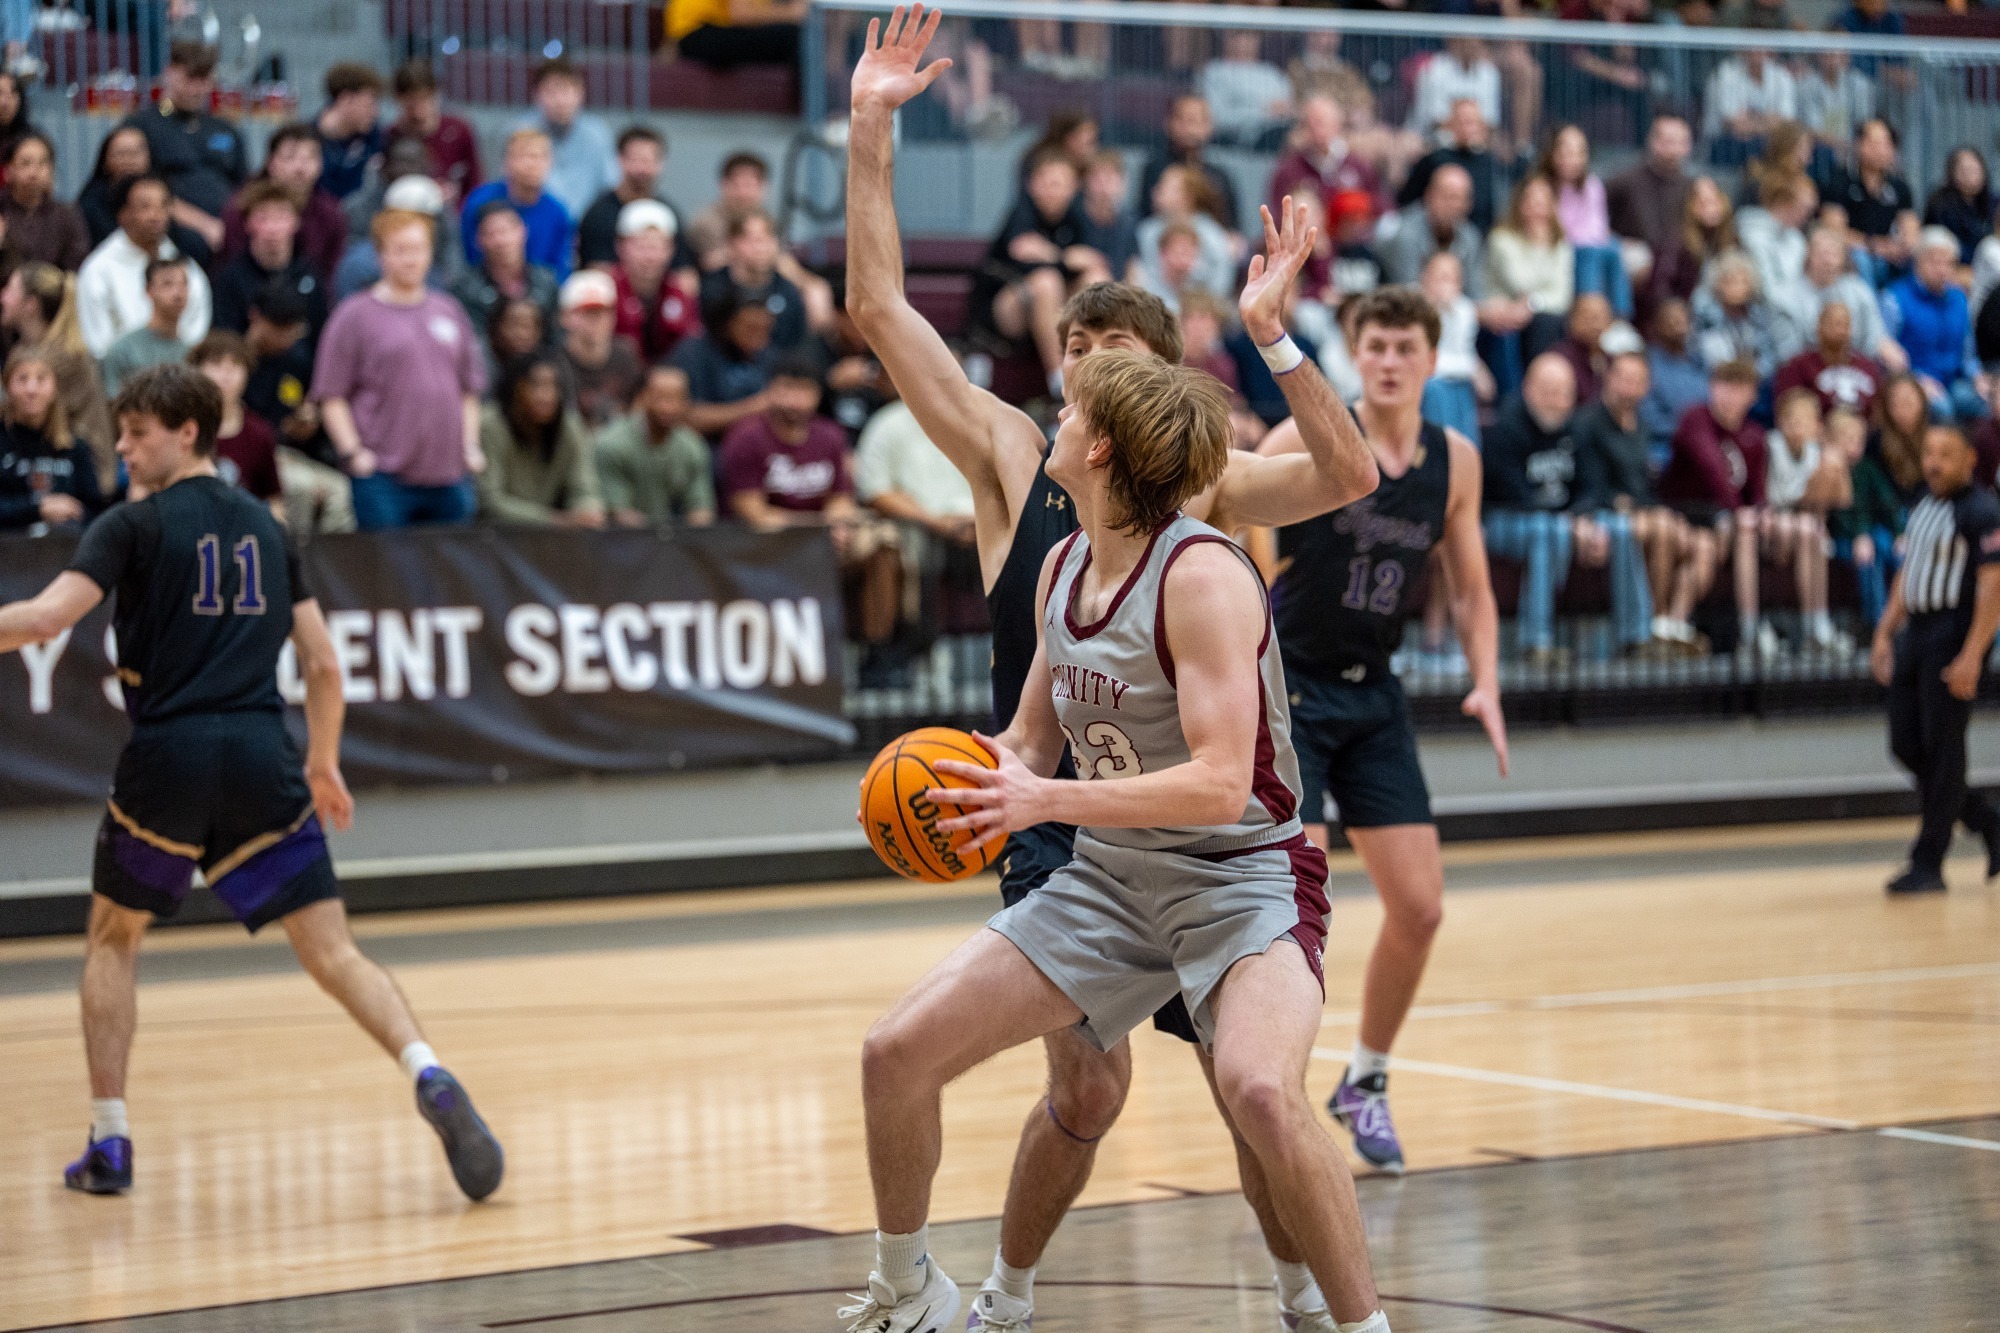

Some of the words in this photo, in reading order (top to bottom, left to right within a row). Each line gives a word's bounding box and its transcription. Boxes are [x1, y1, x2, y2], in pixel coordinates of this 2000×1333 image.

[192, 533, 267, 616] 11
[1341, 555, 1404, 615] 12
[504, 597, 827, 697] SECTION
[1051, 664, 1131, 711] NITY
